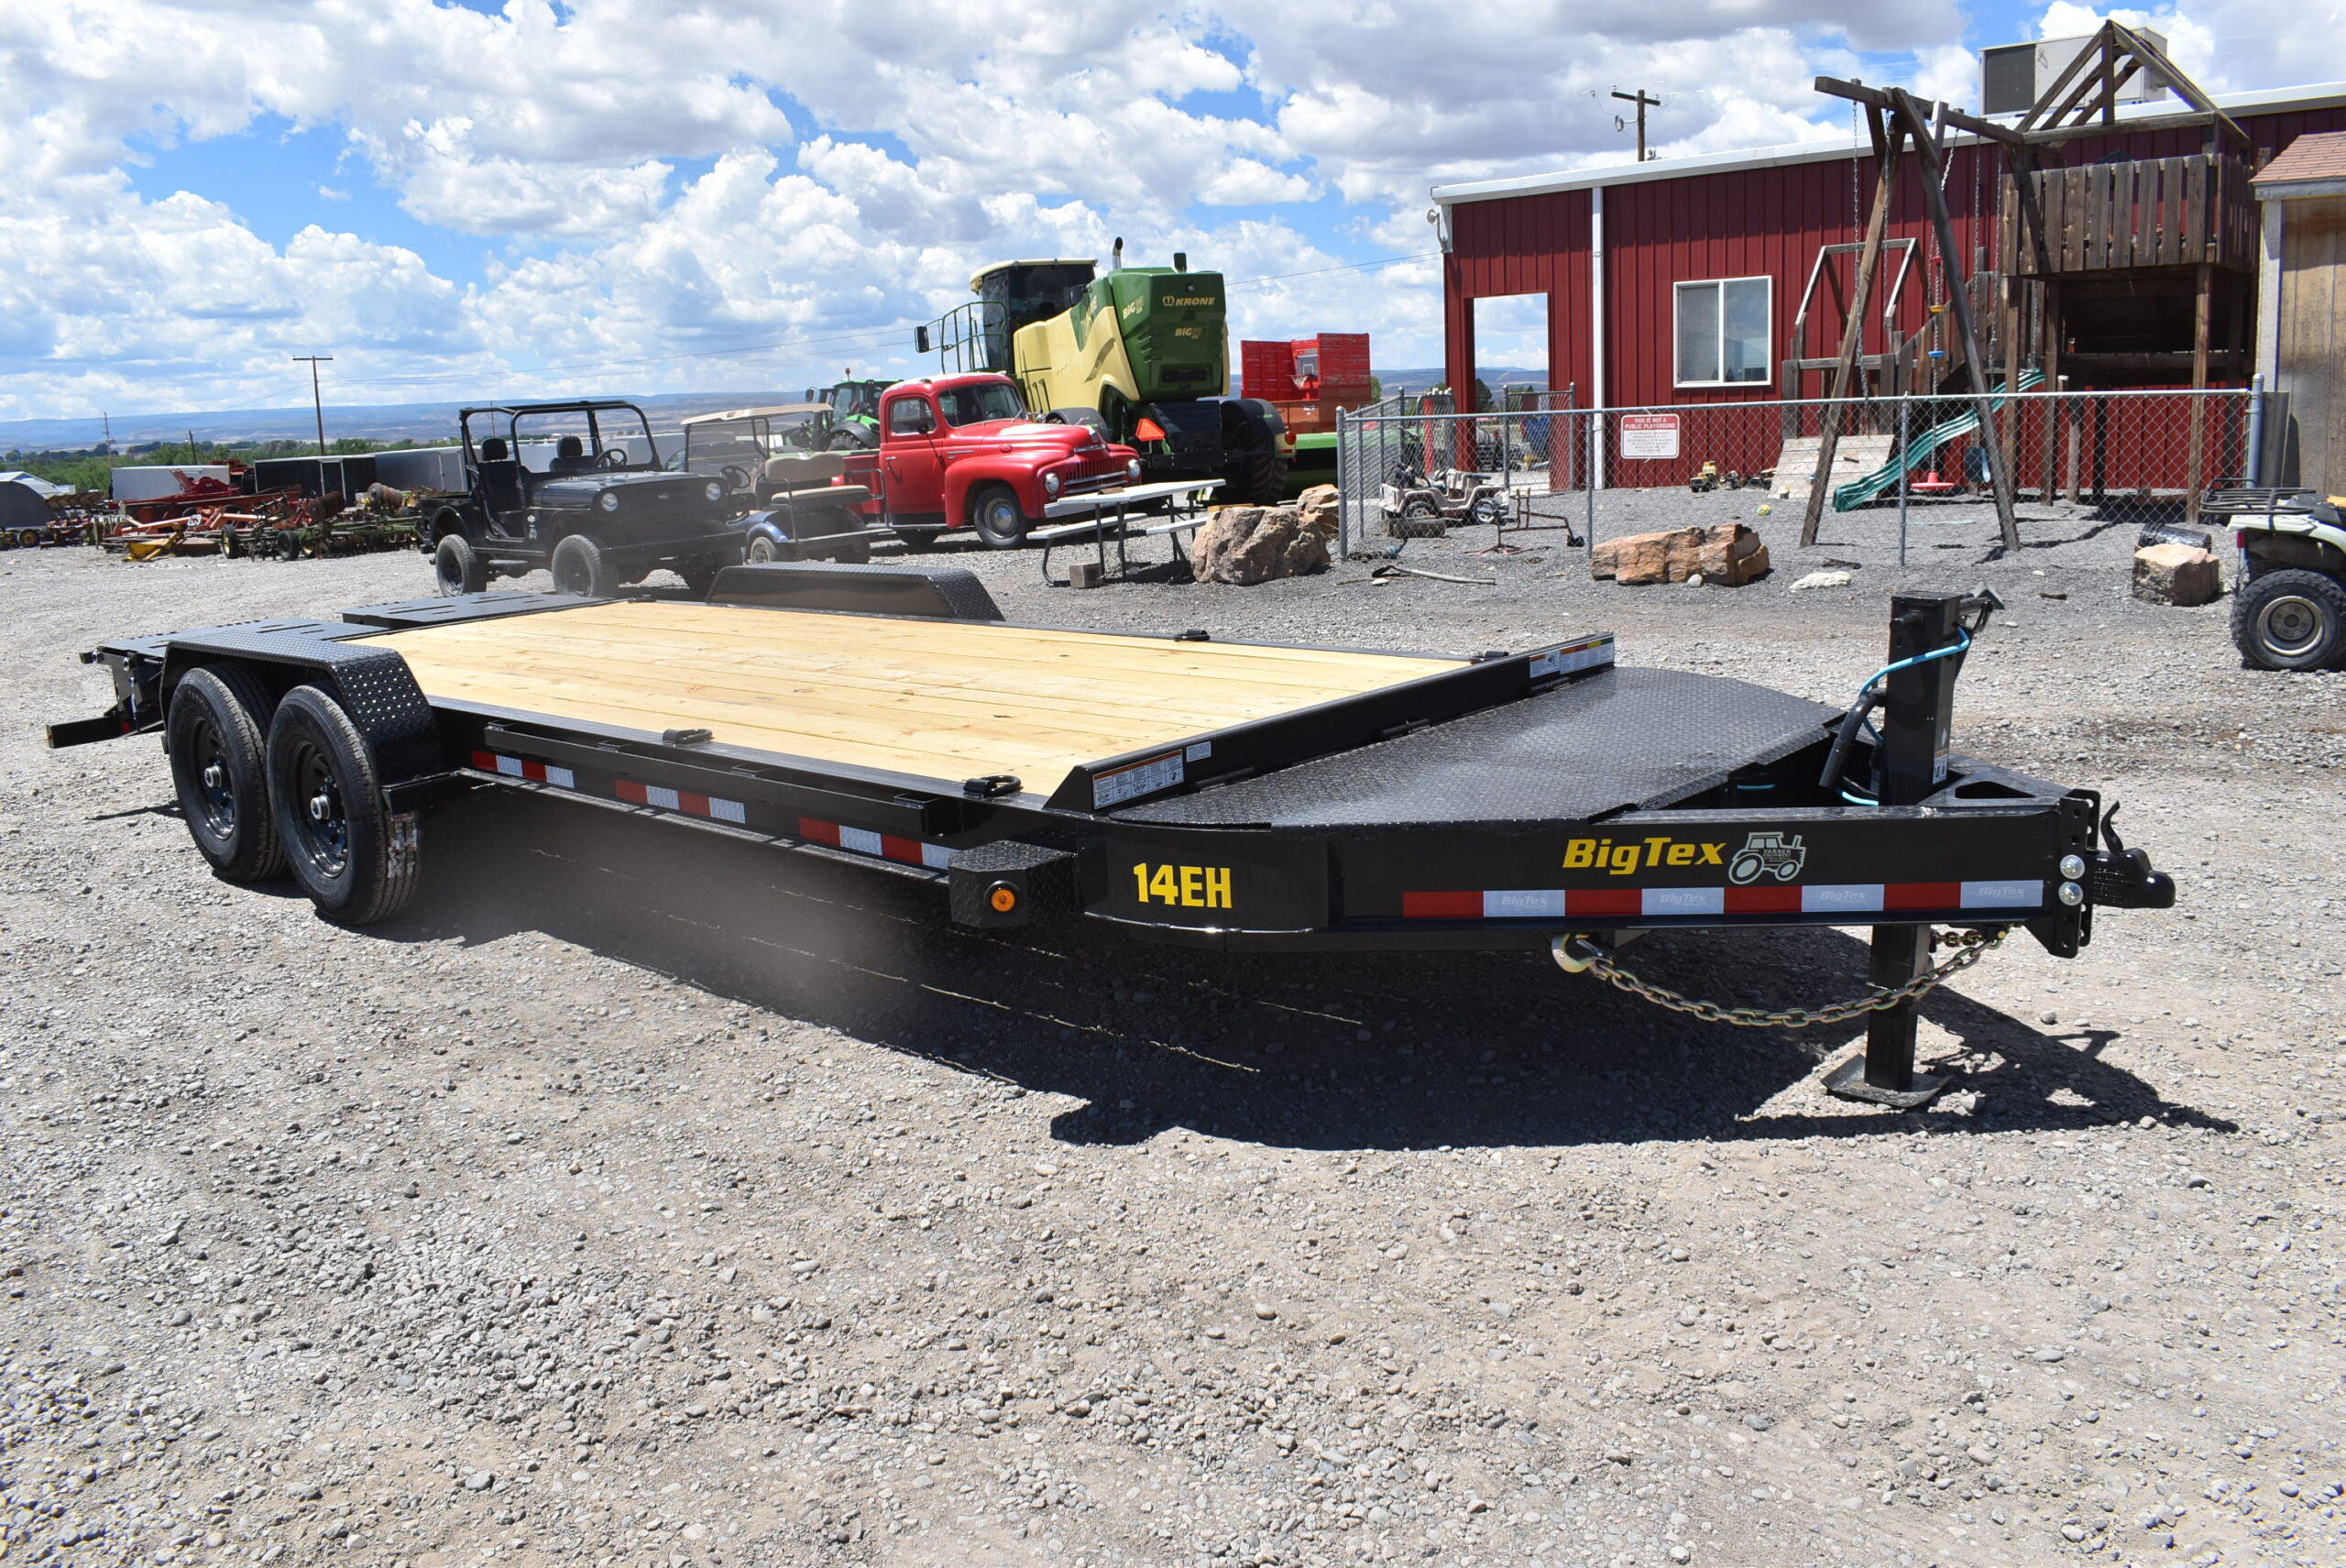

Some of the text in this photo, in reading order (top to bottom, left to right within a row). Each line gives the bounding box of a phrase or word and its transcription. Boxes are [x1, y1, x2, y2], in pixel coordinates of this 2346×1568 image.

[1175, 296, 1216, 306] KRONE
[1562, 837, 1728, 875] BigTex
[1133, 862, 1233, 908] 14EH
[1819, 890, 1868, 902] BigTex
[1979, 886, 2025, 898] BigTex
[1500, 895, 1548, 906] BigTex
[1660, 894, 1707, 905] BigTex
